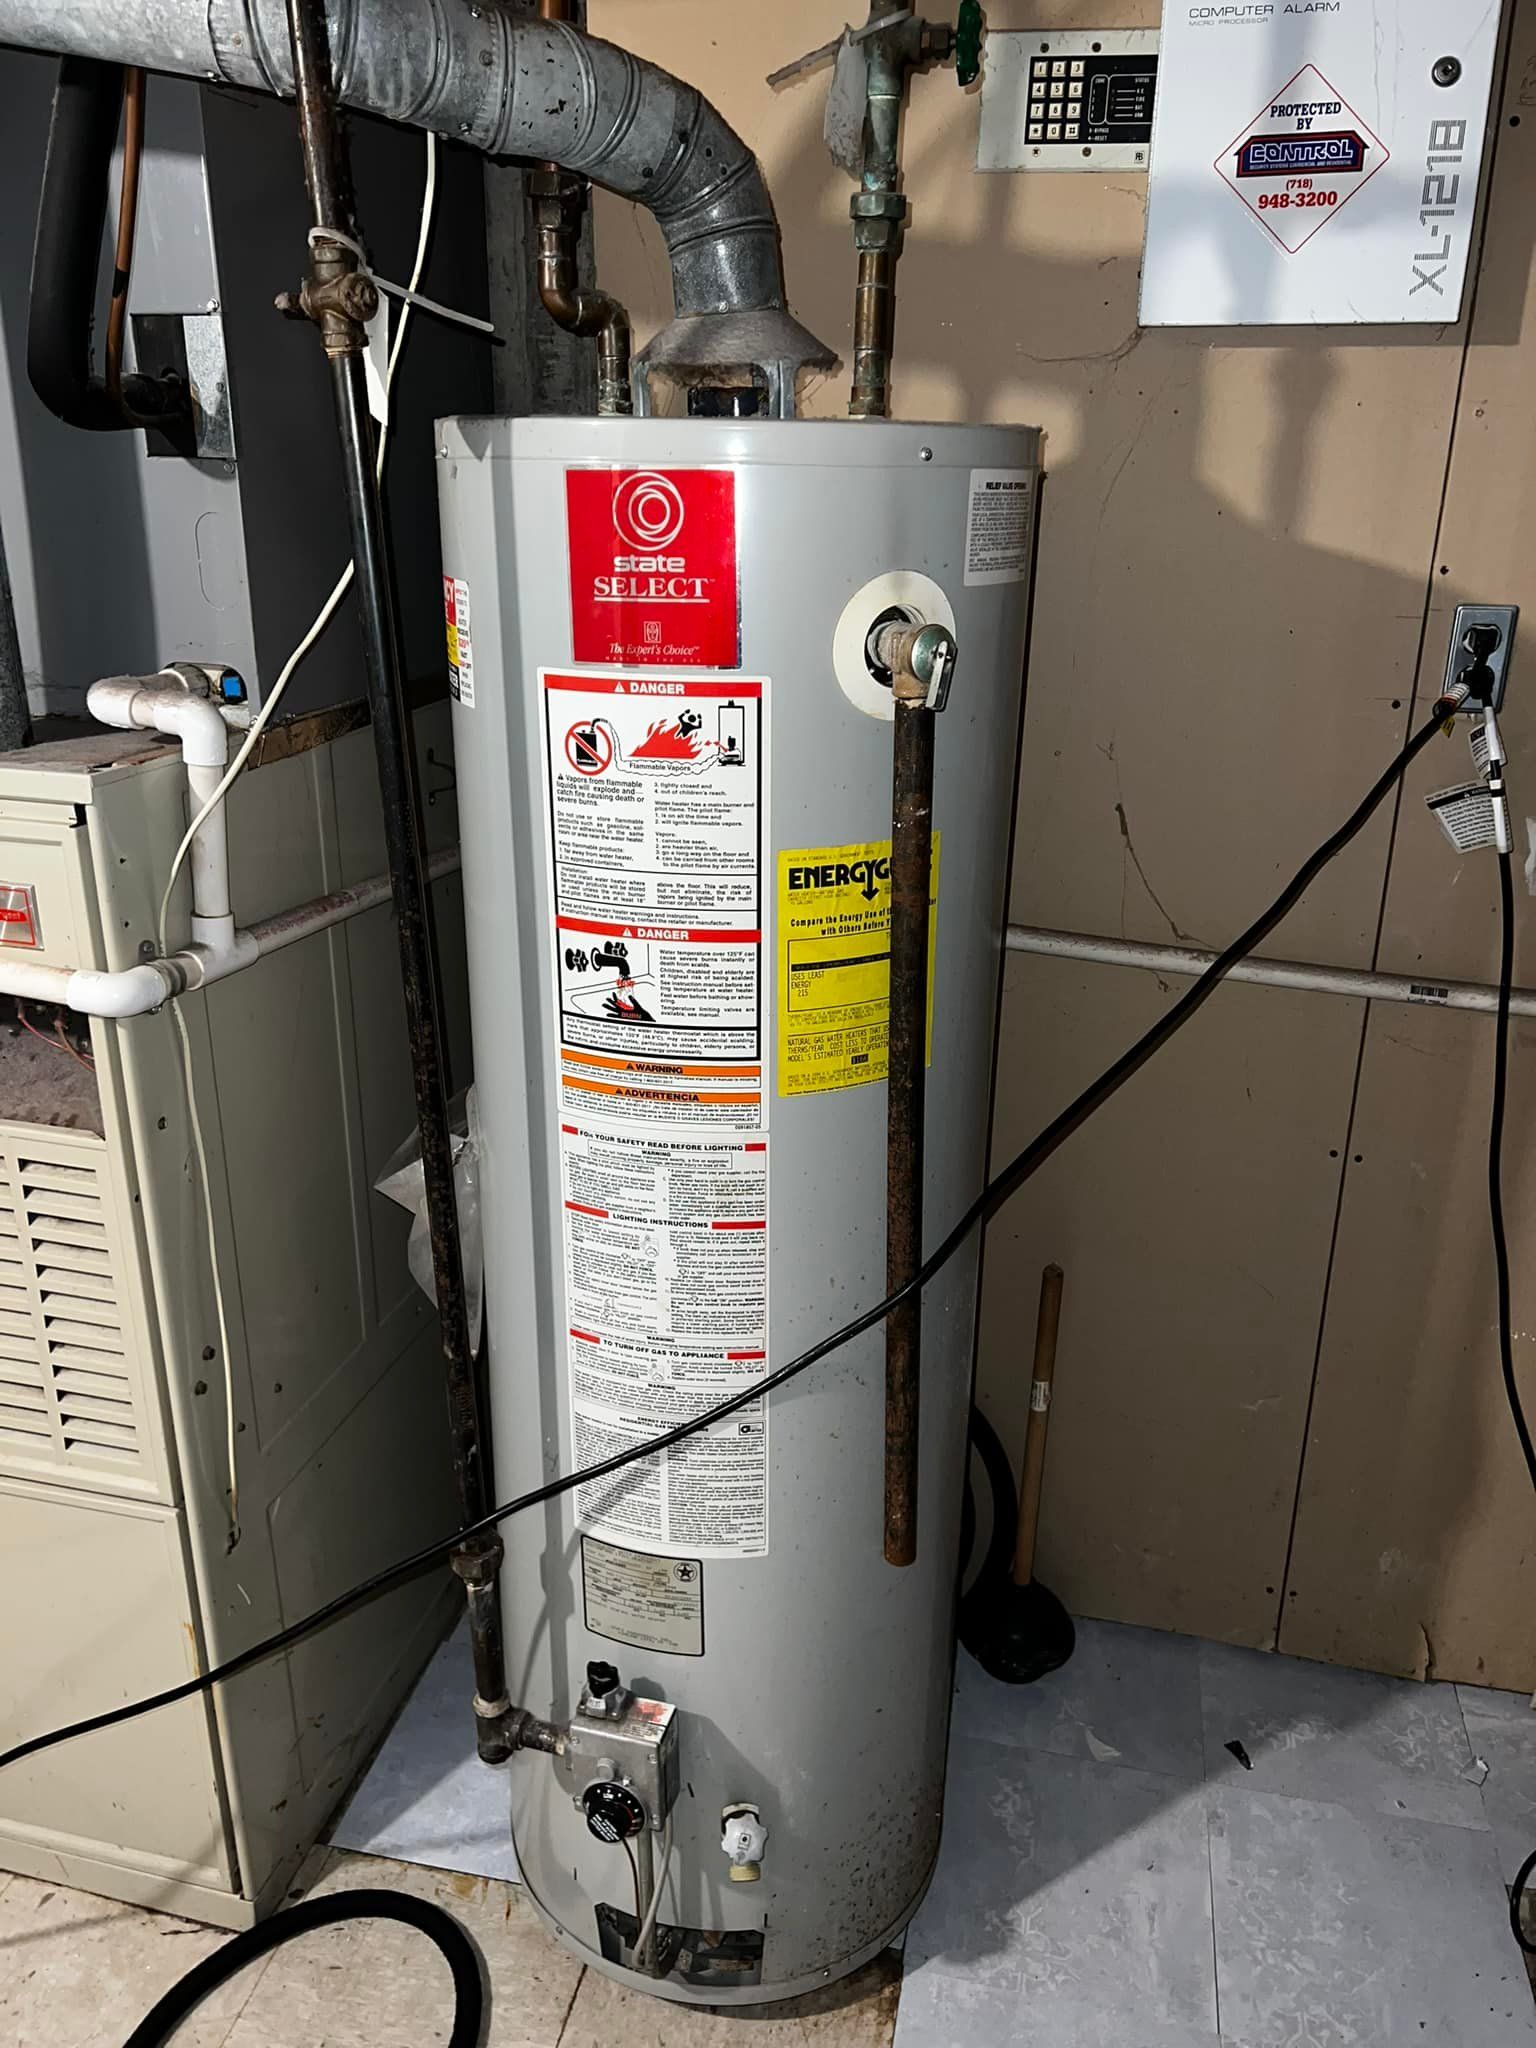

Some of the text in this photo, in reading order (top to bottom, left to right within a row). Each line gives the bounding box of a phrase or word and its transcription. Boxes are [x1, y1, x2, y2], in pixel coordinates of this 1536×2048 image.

[1189, 2, 1340, 18] COMPUTER ALARM
[1057, 64, 1061, 72] 2
[1076, 64, 1080, 72] 3
[1270, 102, 1342, 118] PROTECTED
[1296, 118, 1313, 130] BY
[1250, 139, 1354, 163] CONTROL
[1286, 178, 1313, 191] (718)
[1258, 191, 1338, 209] 948-3200
[1409, 120, 1466, 296] XL-121B
[614, 554, 686, 573] state
[609, 642, 623, 653] The
[630, 682, 685, 695] DANGER
[557, 780, 577, 789] liquids
[566, 775, 587, 783] Vapors
[606, 779, 642, 788] flammable
[587, 793, 613, 802] causing
[790, 918, 823, 928] Compare
[840, 914, 862, 923] Energy
[879, 908, 885, 916] of
[637, 928, 688, 940] DANGER
[821, 921, 884, 936] with Others Before
[791, 971, 824, 980] USES LEAST
[788, 1038, 811, 1046] NATURAL
[827, 1033, 842, 1042] WATER
[845, 1028, 867, 1039] HEATERS
[869, 1026, 880, 1035] THAT
[830, 1041, 842, 1049] COST
[845, 1039, 858, 1048] LESS
[860, 1037, 866, 1045] TO
[814, 1051, 843, 1060] ESTIMATED
[846, 1047, 864, 1056] YEARLY
[636, 1063, 683, 1075] WARNING
[624, 1088, 700, 1102] ADVERTENCIA
[617, 1138, 645, 1146] SAFETY
[647, 1141, 669, 1150] READ
[612, 1213, 708, 1228] LIGHTING INSTRUCTIONS
[615, 1342, 634, 1351] TURN
